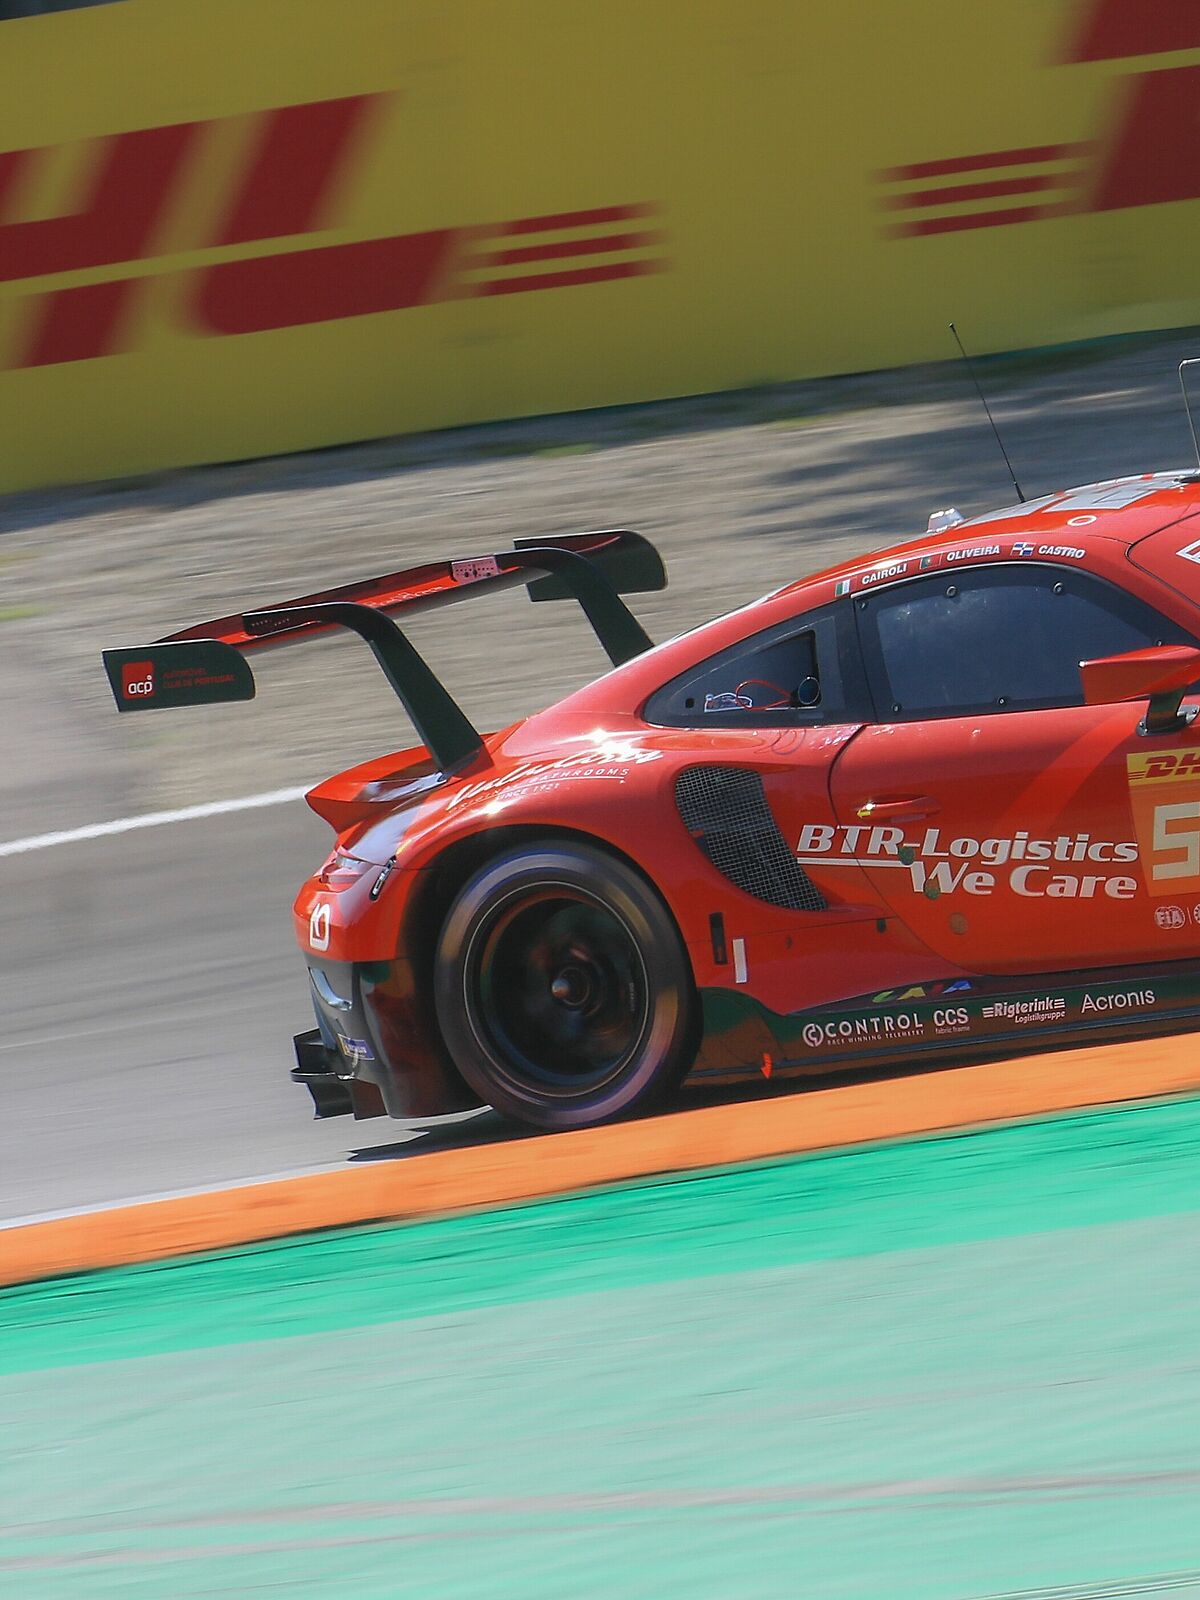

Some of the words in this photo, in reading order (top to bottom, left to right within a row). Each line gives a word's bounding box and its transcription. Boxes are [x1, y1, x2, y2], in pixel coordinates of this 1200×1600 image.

[946, 545, 1000, 562] OLIVEIRA
[1038, 545, 1085, 559] CASTRO
[861, 564, 907, 585] CAIROLI
[128, 677, 153, 694] acp
[797, 825, 1138, 865] BTR-Logistics
[910, 861, 995, 895] We
[1010, 865, 1138, 899] Care
[994, 997, 1054, 1018] Rigterink
[1081, 990, 1156, 1013] Acronis
[825, 1013, 923, 1038] CONTROL
[933, 1008, 969, 1027] CCS
[1015, 1010, 1066, 1024] Logistikgruppe
[848, 1034, 882, 1044] WINNING
